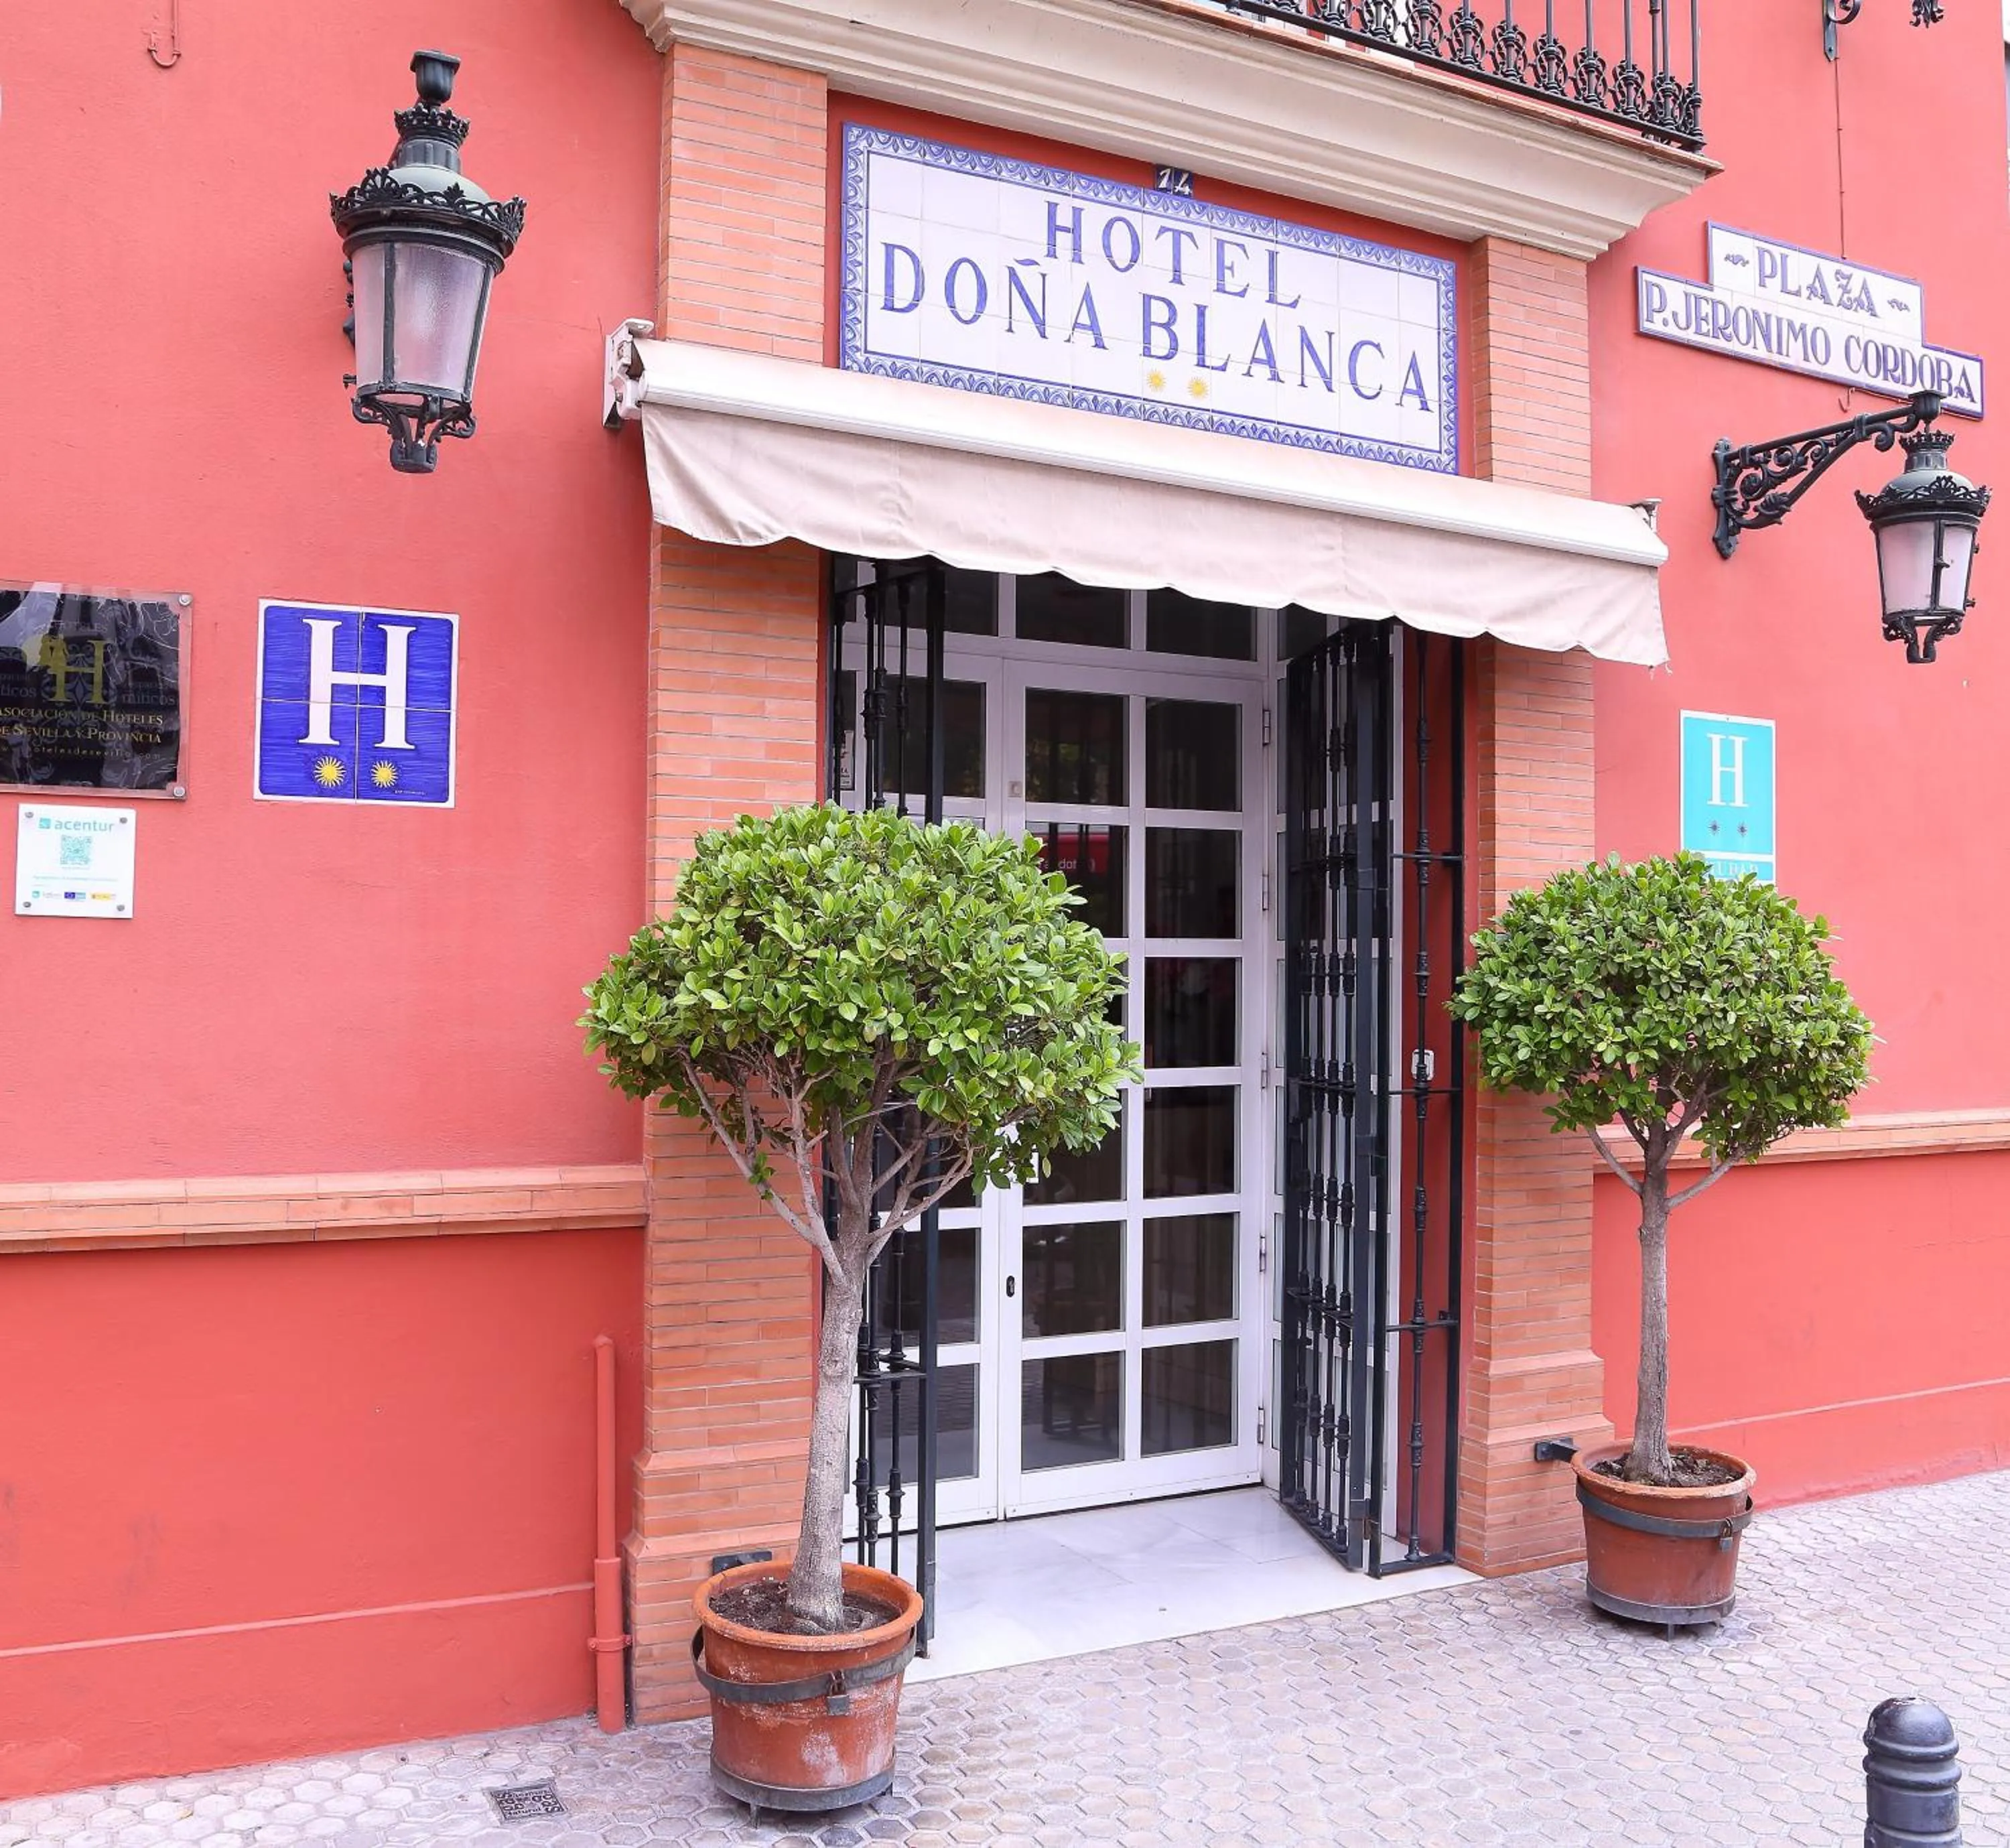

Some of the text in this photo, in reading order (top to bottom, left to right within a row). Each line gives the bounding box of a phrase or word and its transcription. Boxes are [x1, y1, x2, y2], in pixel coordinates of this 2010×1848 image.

[1158, 168, 1190, 195] 14
[1046, 200, 1302, 310] HOTEL
[1756, 246, 1879, 318] PLAZA
[880, 242, 1434, 413] DOÑA BLANCA
[1845, 334, 1977, 403] CORDOBA
[103, 710, 163, 726] HOTELES
[297, 618, 416, 749] H
[12, 722, 74, 738] SEVILLA
[87, 726, 161, 744] PROVINCIA
[1706, 732, 1749, 807] H
[54, 819, 115, 832] acentur
